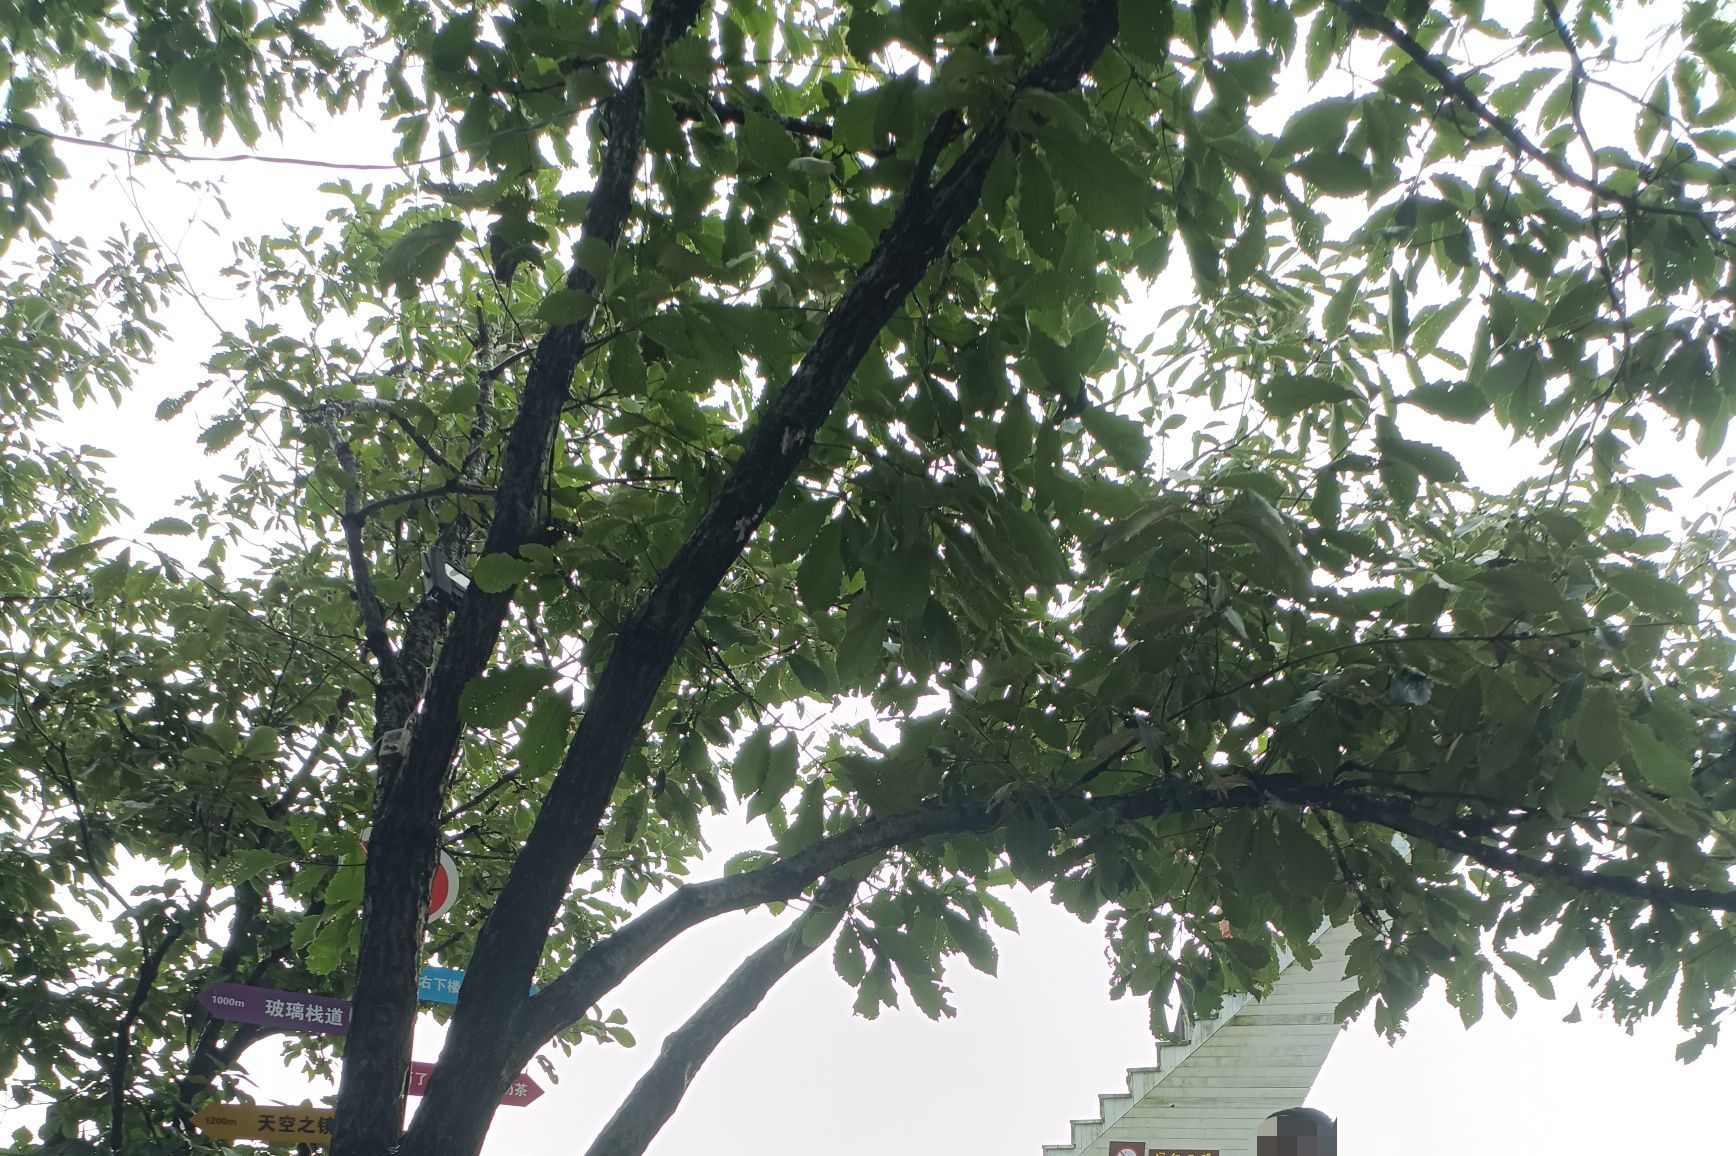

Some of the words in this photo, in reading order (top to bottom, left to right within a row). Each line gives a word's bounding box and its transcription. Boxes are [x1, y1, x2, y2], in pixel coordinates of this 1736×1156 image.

[211, 995, 245, 1008] 1000m
[264, 999, 344, 1026] 玻璃栈道
[204, 1116, 237, 1126] 1200m
[258, 1114, 336, 1135] 天空之镜
